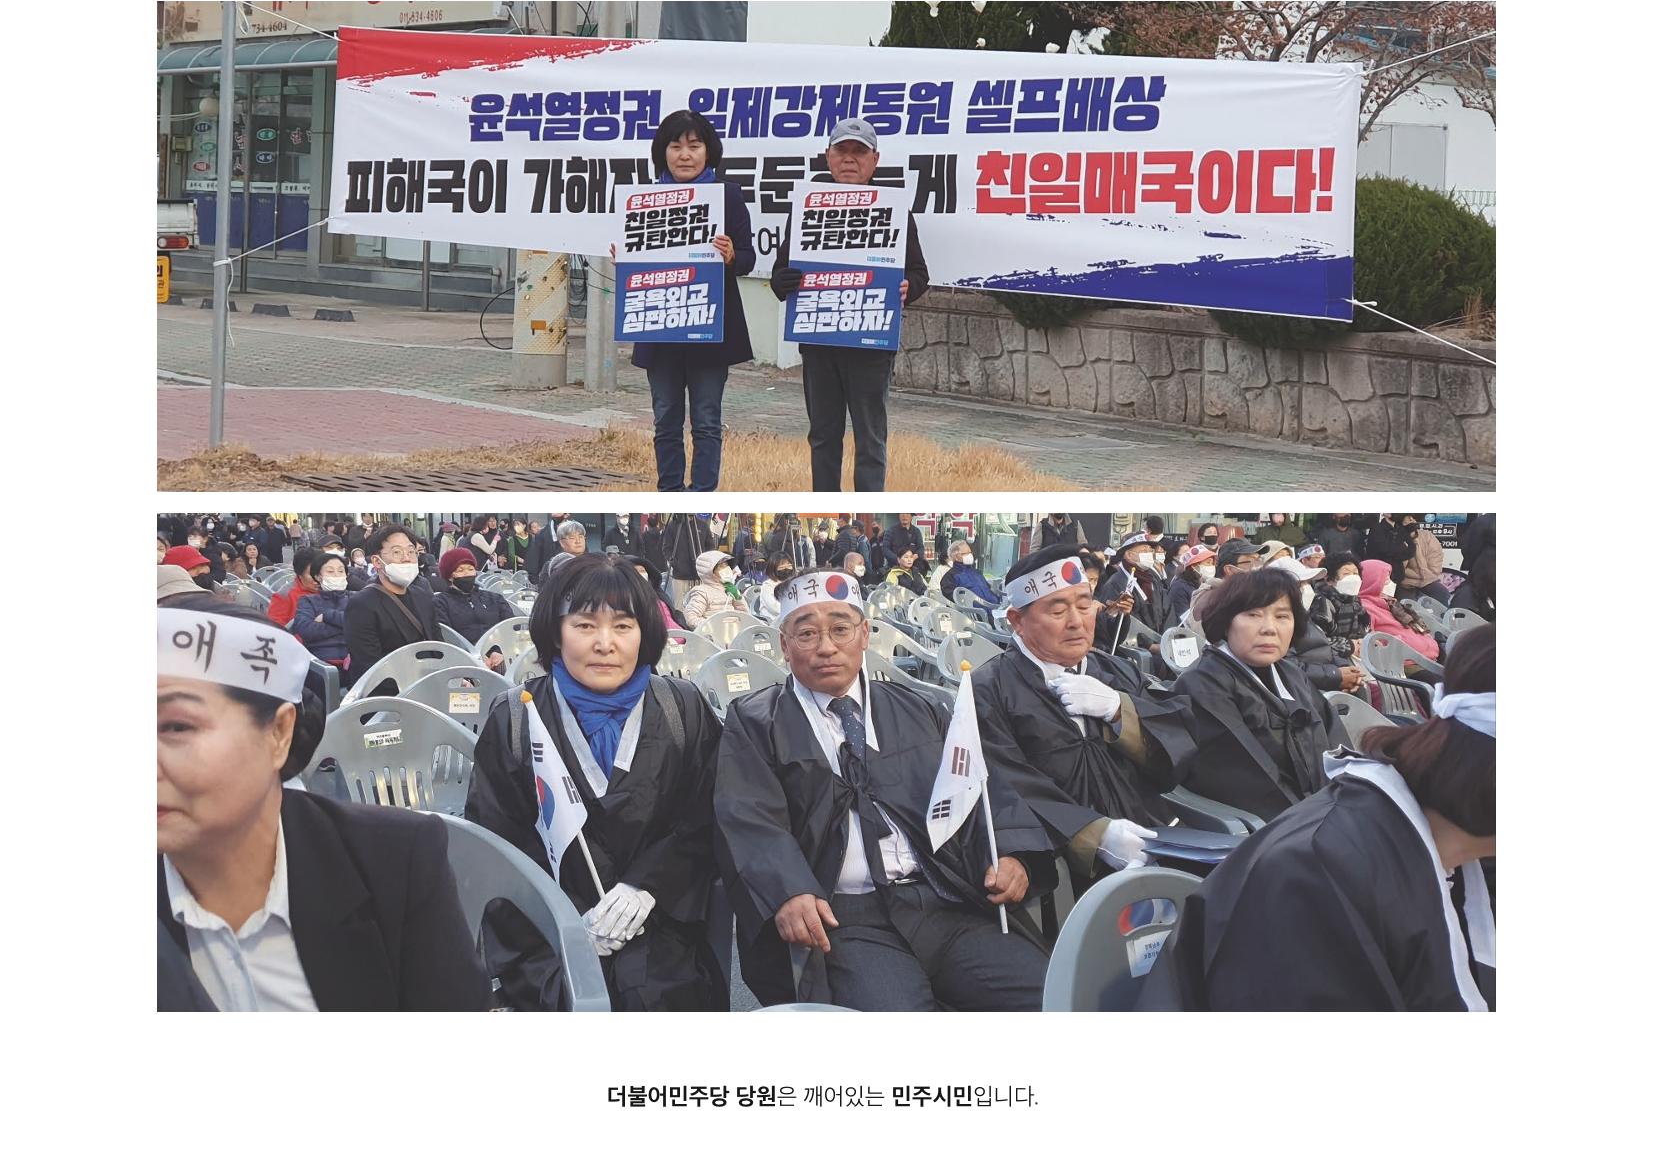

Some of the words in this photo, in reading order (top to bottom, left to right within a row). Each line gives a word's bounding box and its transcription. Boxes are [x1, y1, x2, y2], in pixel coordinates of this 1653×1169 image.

[469, 89, 661, 142] 윤석열정권
[688, 81, 953, 139] 일제강제동원
[967, 75, 1167, 135] 셀프배상
[345, 157, 507, 214] 피해국이
[976, 146, 1336, 215] 친일매국이다!
[631, 190, 690, 209] 윤석열정권
[810, 192, 873, 207] 윤석열정권
[624, 204, 710, 232] 친일정권
[801, 207, 893, 230] 친일정권
[624, 224, 717, 253] 규탄한다!
[800, 229, 900, 251] 규탄한다!
[630, 269, 690, 288] 윤석열정권
[803, 272, 867, 287] 윤석열정권
[624, 283, 709, 313] 굴욕외교
[795, 288, 886, 313] 굴욕외교
[622, 303, 717, 334] 심판하자!
[793, 310, 894, 334] 심판하자!
